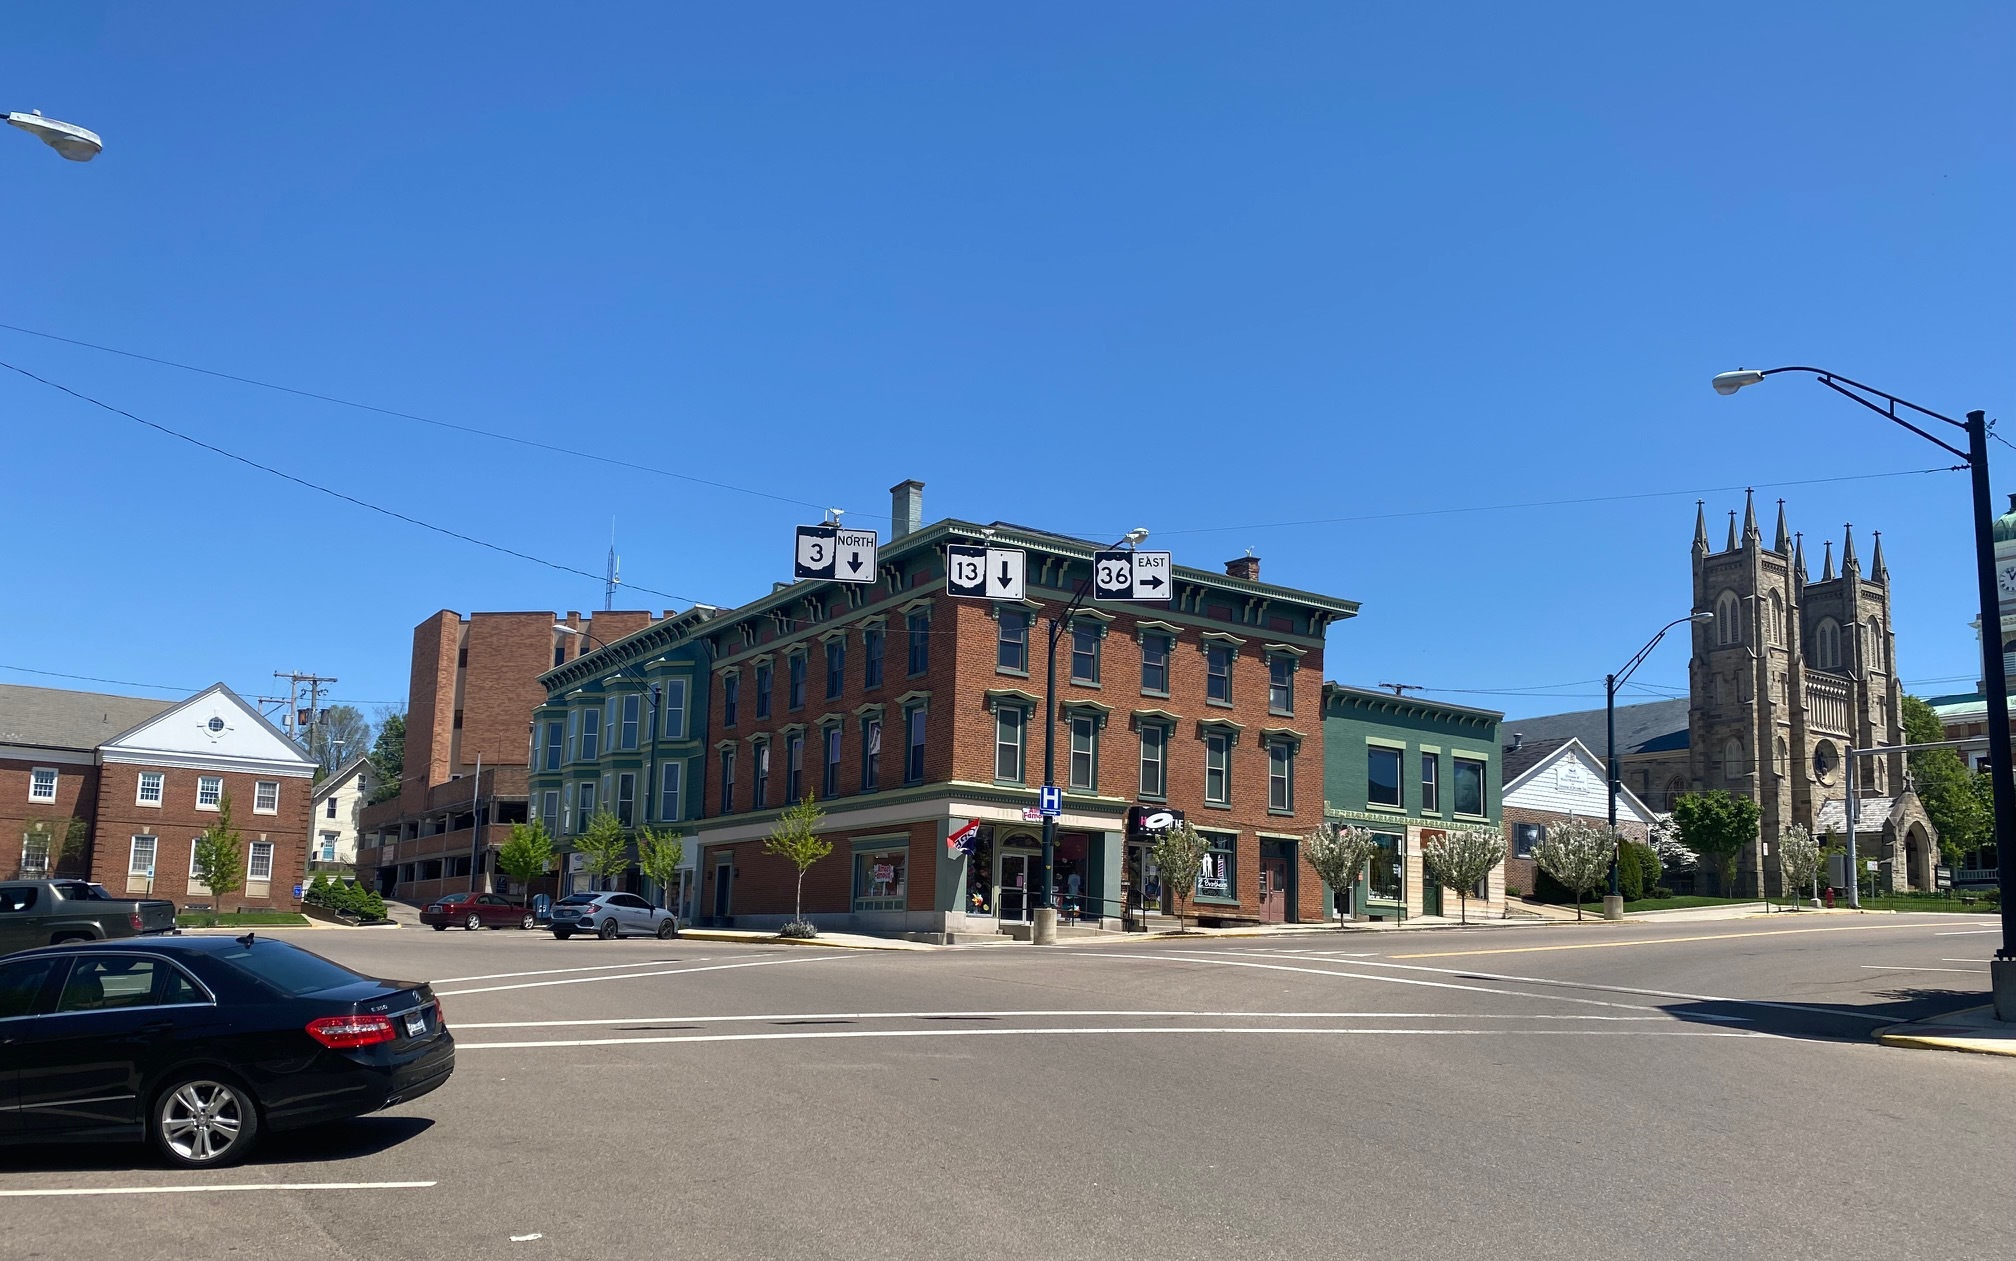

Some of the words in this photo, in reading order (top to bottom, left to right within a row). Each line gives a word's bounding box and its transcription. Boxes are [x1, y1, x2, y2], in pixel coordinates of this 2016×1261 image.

[837, 535, 874, 547] NORTH
[809, 543, 824, 562] 3
[1138, 557, 1165, 567] EAST
[957, 561, 978, 581] 13
[1100, 566, 1128, 585] 36
[1043, 788, 1059, 809] H
